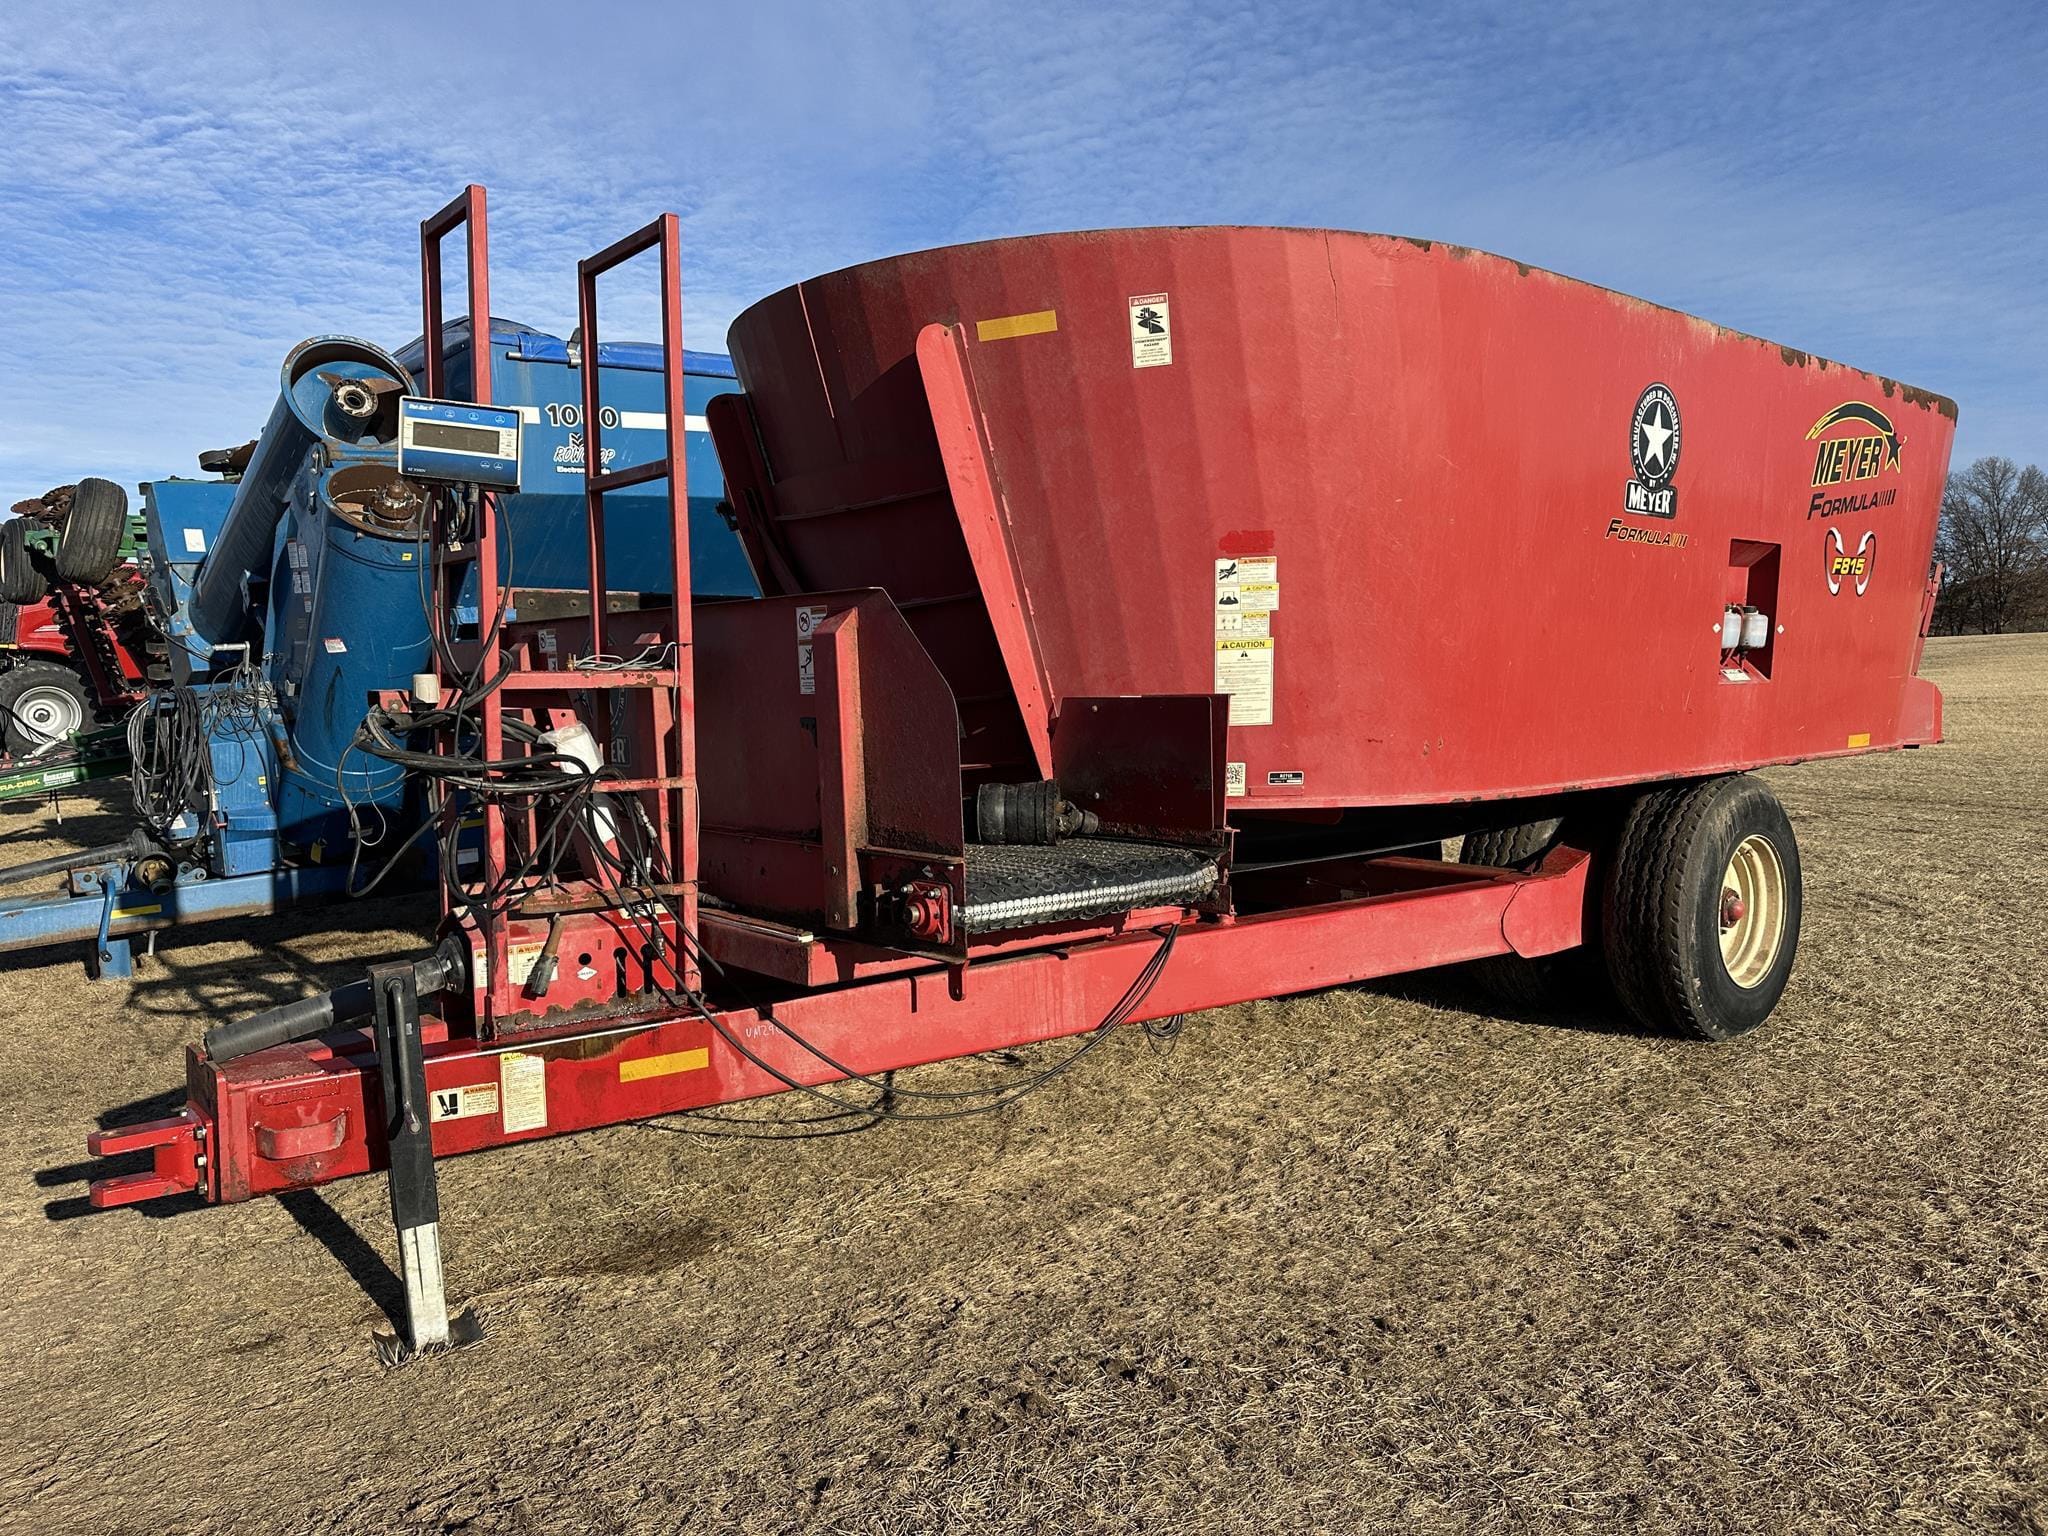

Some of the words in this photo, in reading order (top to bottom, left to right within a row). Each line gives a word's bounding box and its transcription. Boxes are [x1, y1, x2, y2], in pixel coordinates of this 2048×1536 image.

[1140, 296, 1165, 305] DANGER
[544, 403, 619, 430] 100
[1632, 390, 1657, 457] MANUFACTURED
[1811, 435, 1885, 488] MEYER
[1648, 478, 1657, 488] BY
[1628, 484, 1671, 514] MEYER
[1832, 557, 1866, 575] F815
[1229, 641, 1266, 649] CAUTION
[469, 1083, 497, 1095] WARNING
